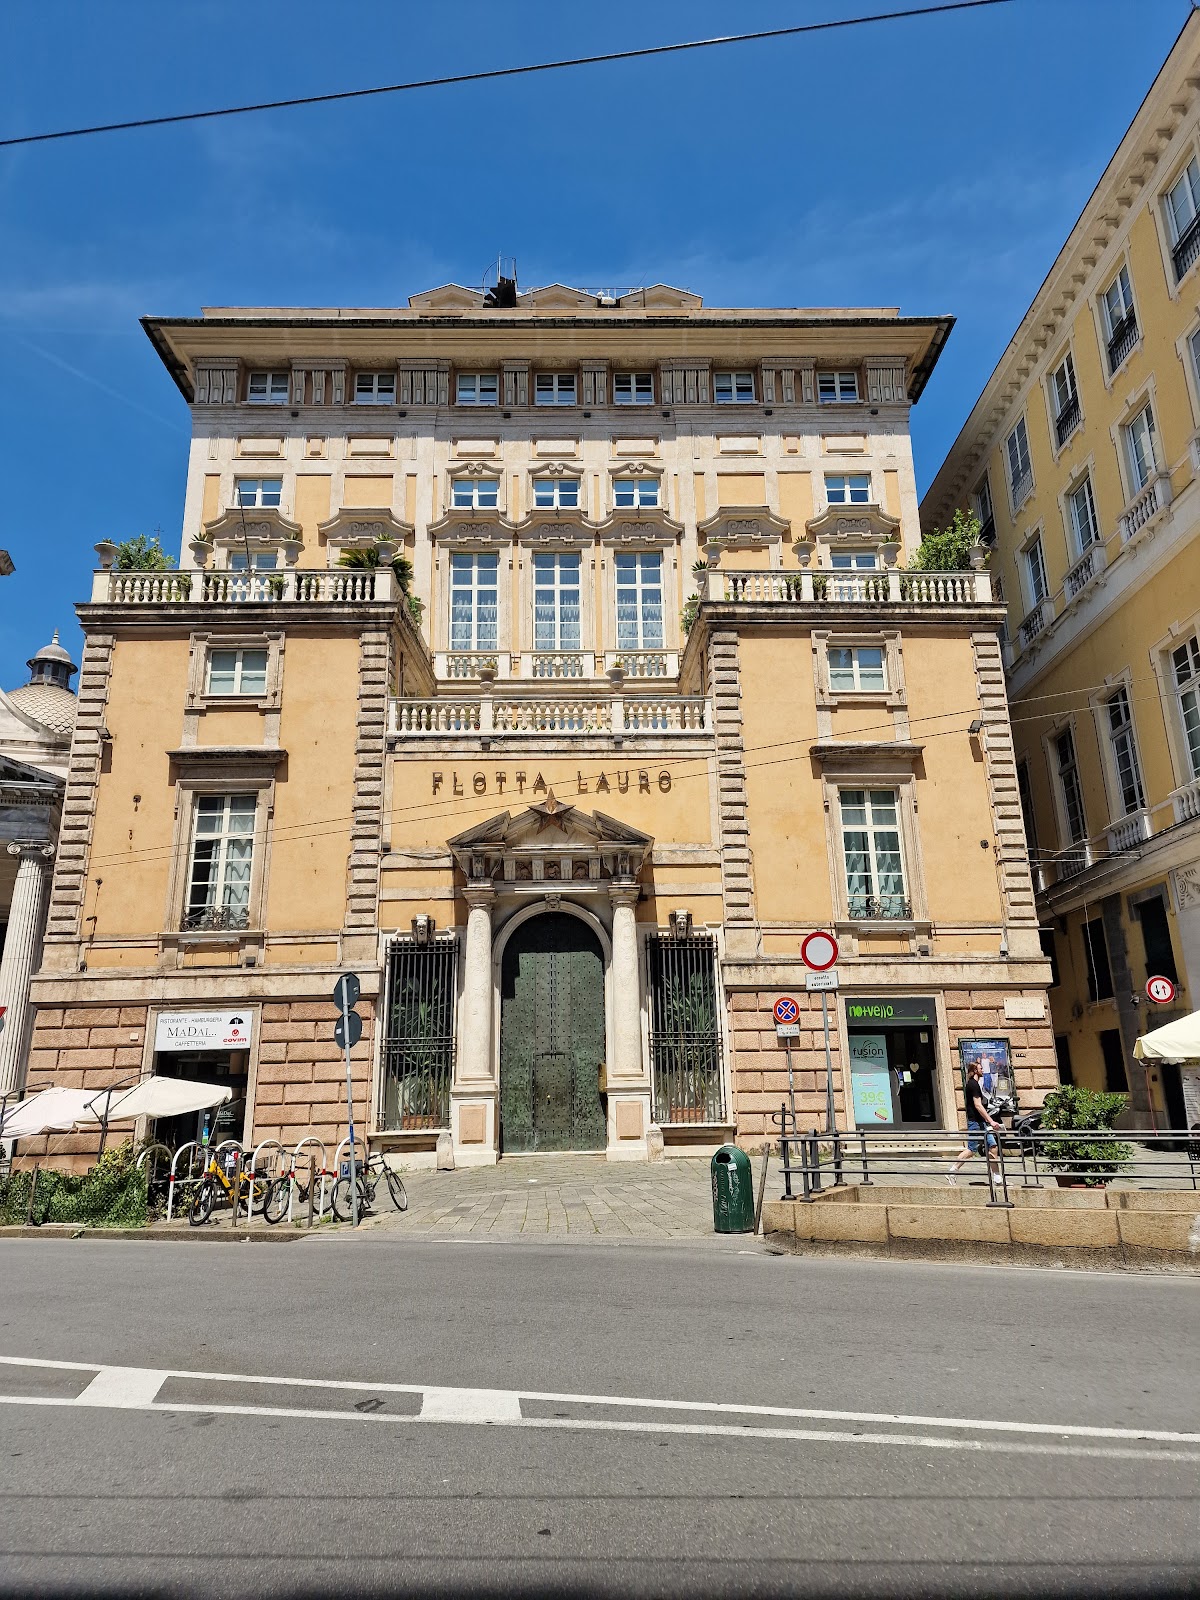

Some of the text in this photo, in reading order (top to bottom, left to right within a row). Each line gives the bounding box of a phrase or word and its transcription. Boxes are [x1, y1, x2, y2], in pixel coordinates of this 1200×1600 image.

[432, 770, 672, 795] FLOTTA LAURO
[852, 1045, 884, 1056] fusion
[860, 1091, 886, 1103] 39€
